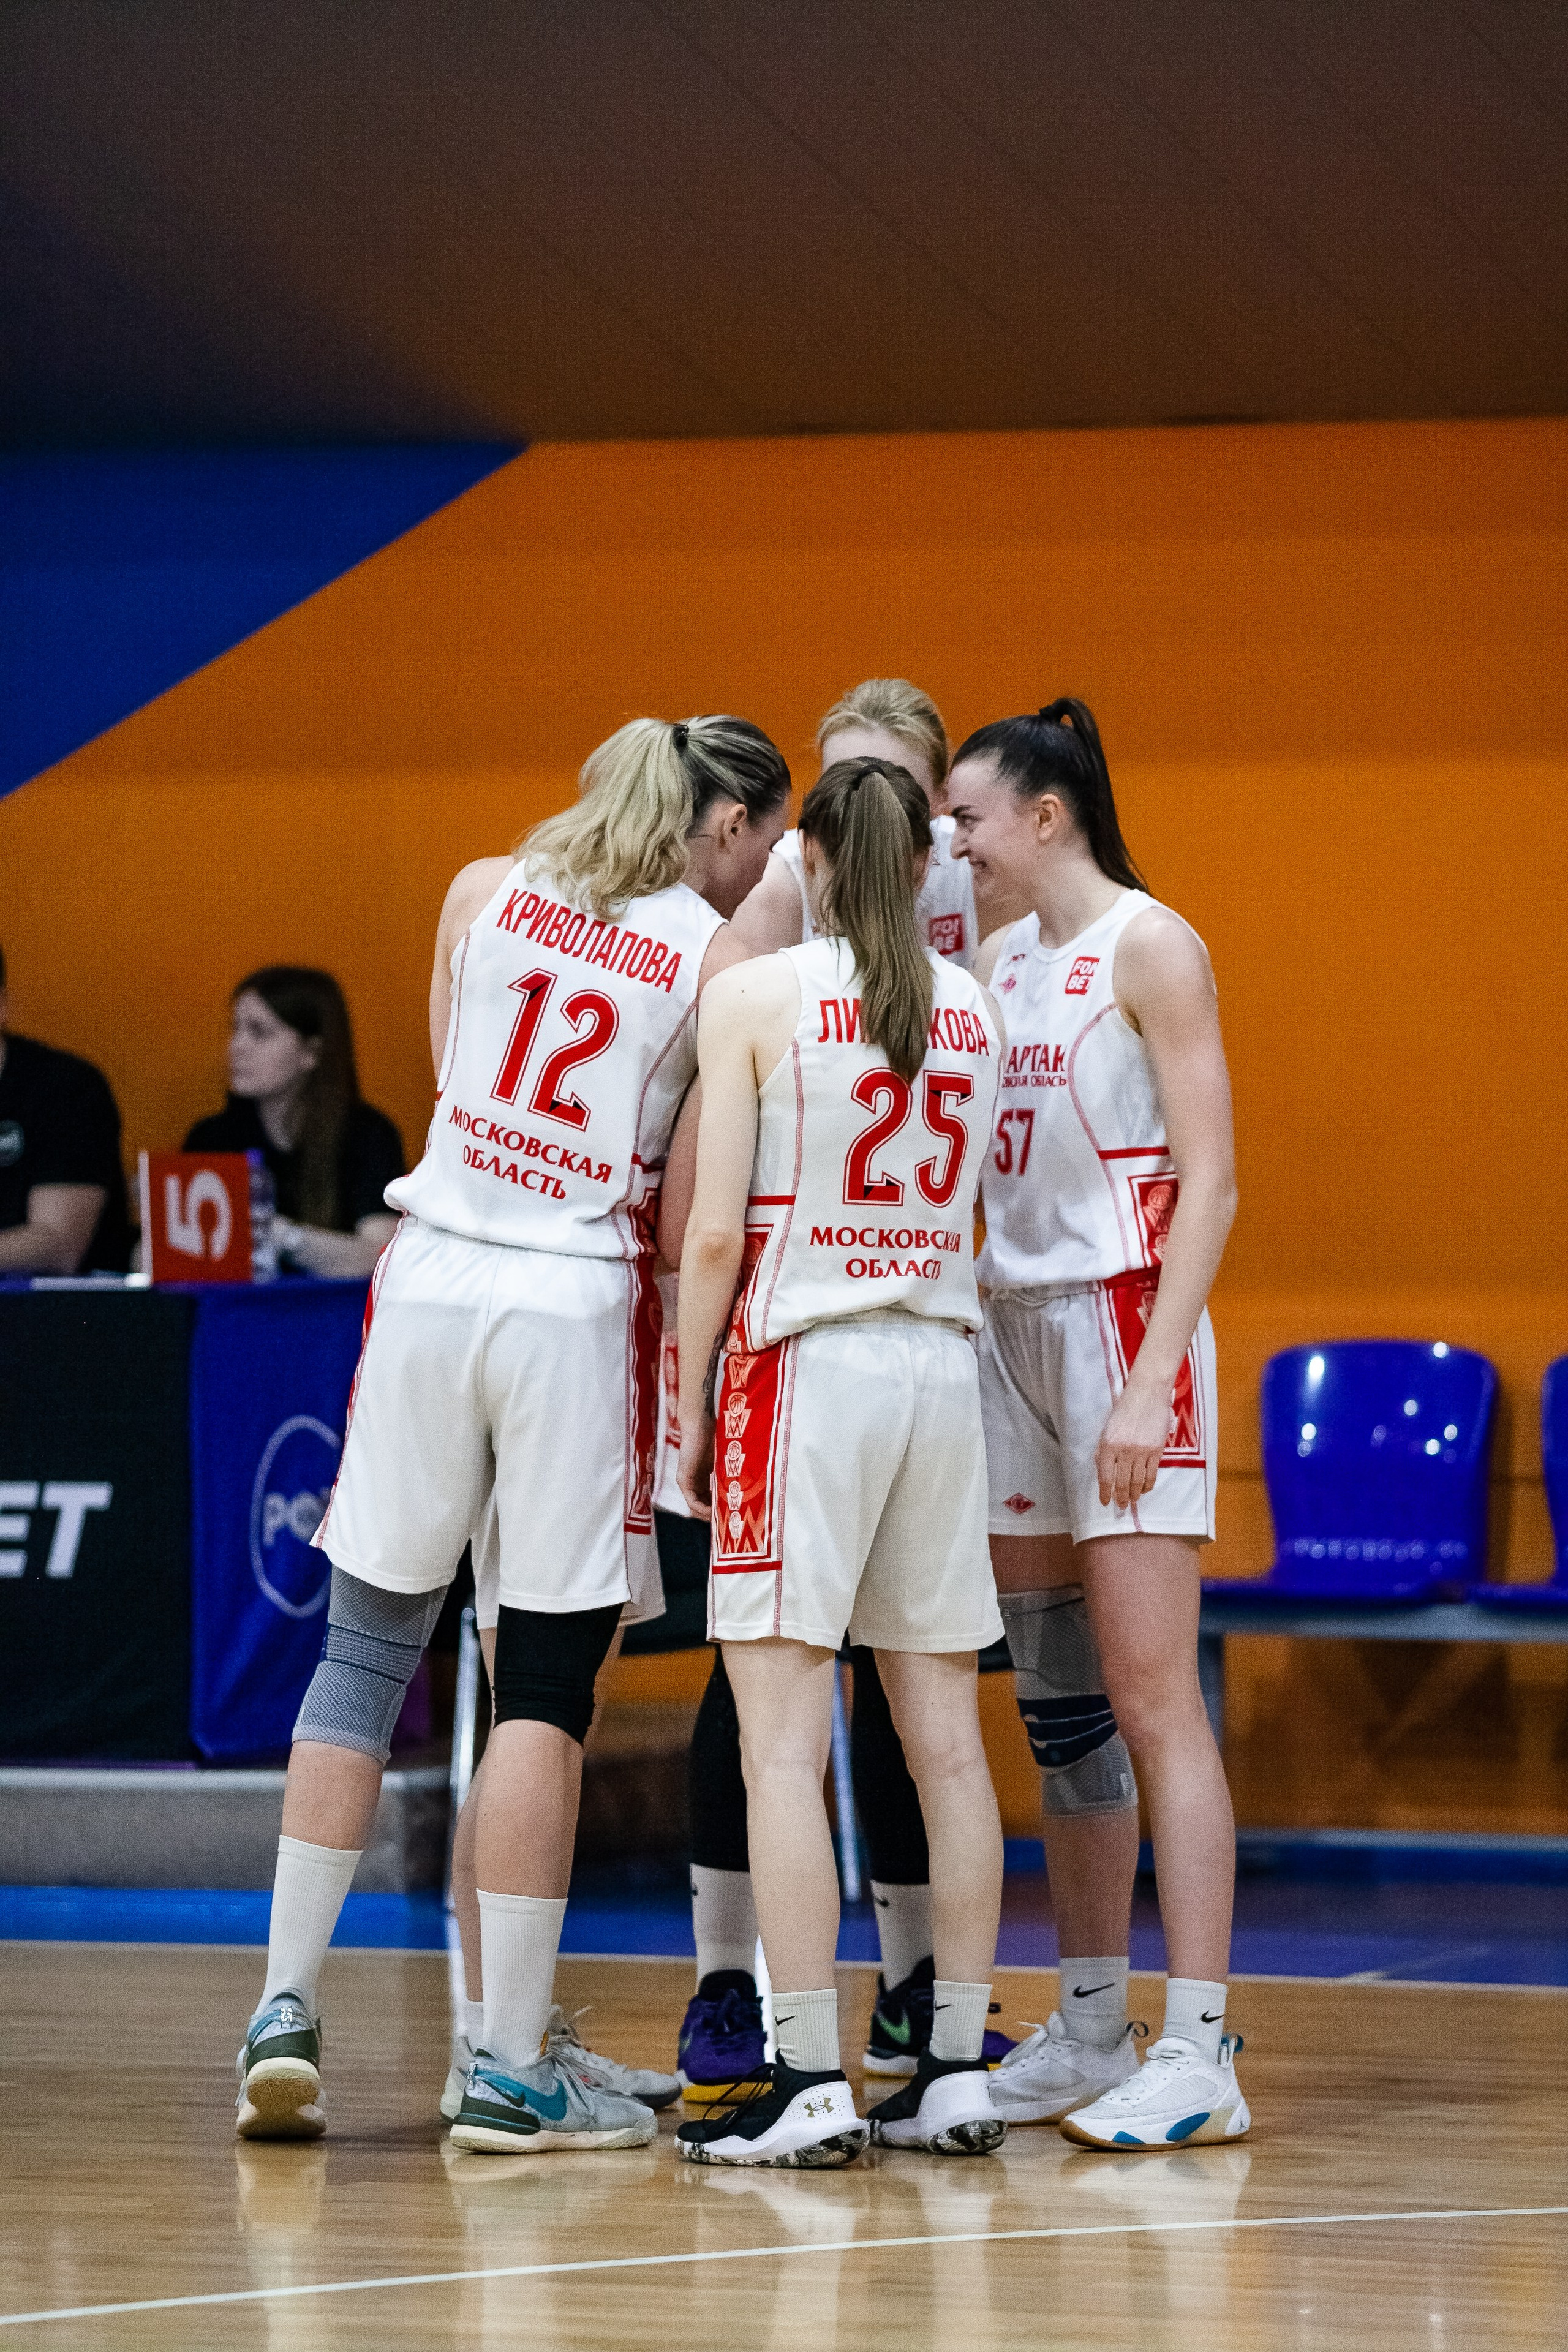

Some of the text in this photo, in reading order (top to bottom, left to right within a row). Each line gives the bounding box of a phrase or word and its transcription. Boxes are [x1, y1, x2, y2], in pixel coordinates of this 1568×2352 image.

[496, 889, 682, 993] КРИВОЛАПОВА
[490, 967, 620, 1133] 12
[817, 998, 989, 1057] ЛИКОВА
[1006, 1043, 1068, 1073] АРТАК
[448, 1105, 612, 1184] МОСКОВСКАЯ
[462, 1145, 567, 1200] ОБЛАСТЬ
[842, 1067, 974, 1208] 25
[994, 1108, 1036, 1177] 57
[164, 1169, 233, 1263] 5
[809, 1226, 961, 1253] МОСКОВСКАЯ
